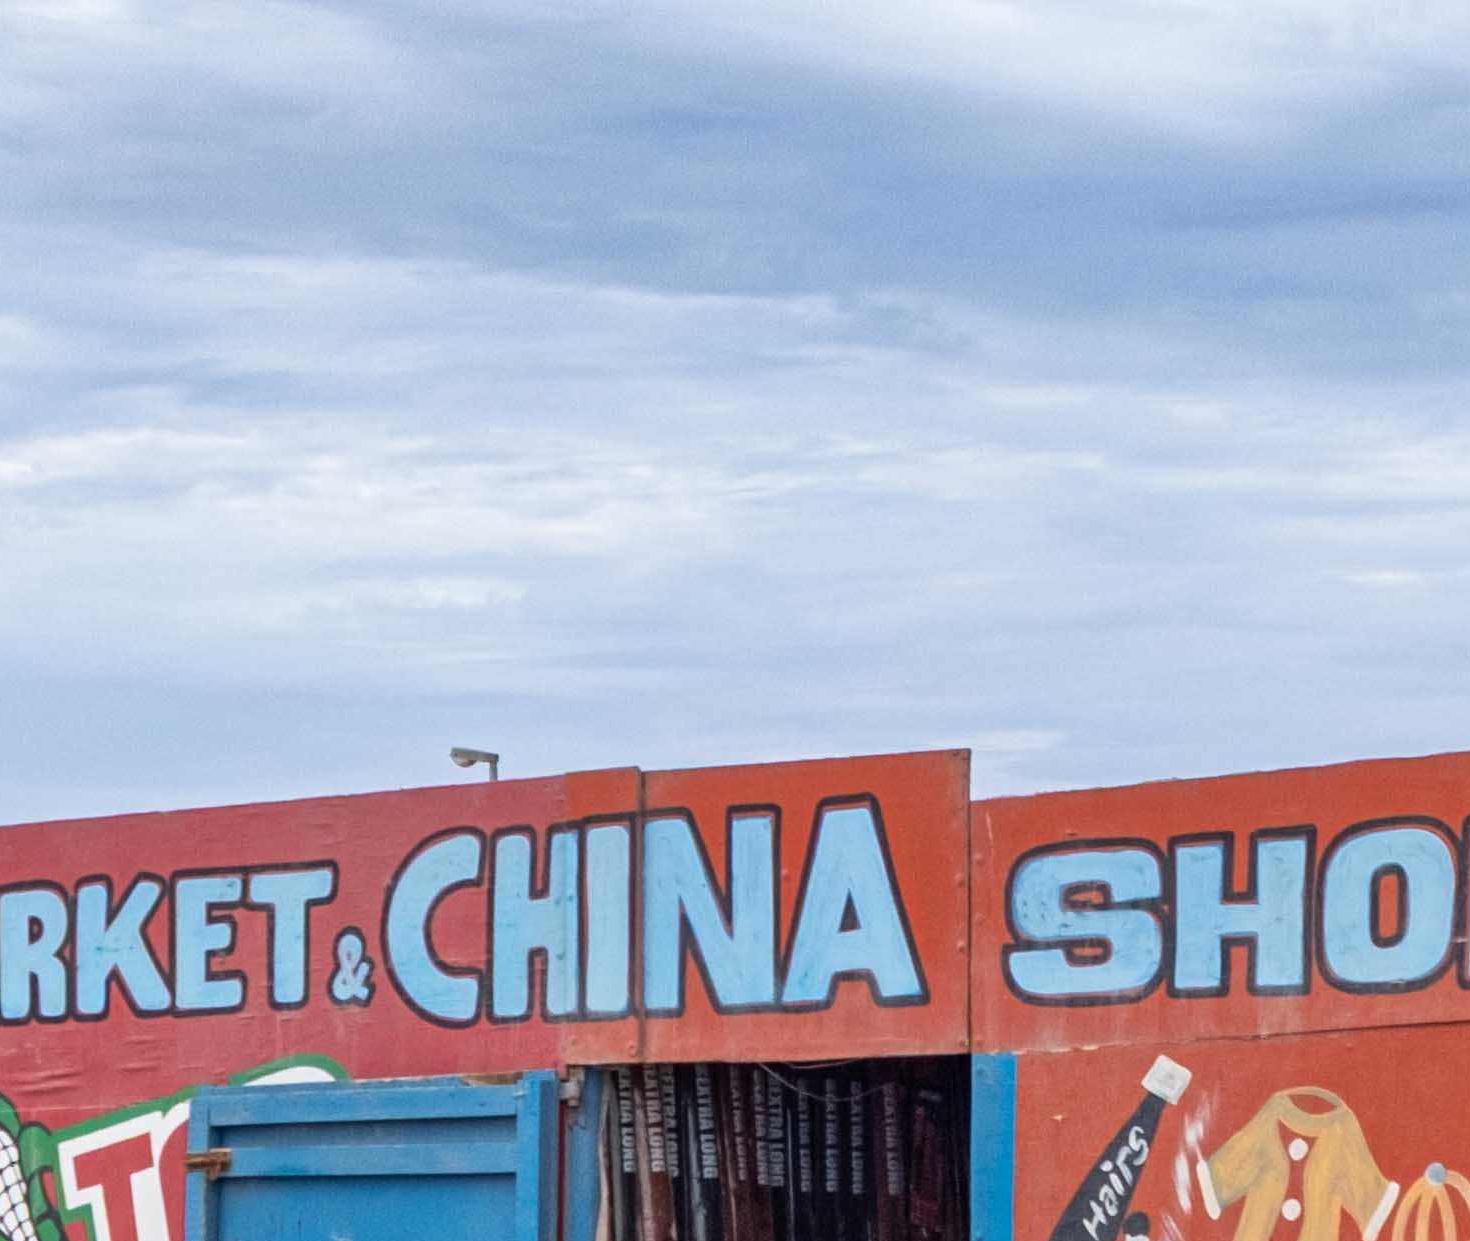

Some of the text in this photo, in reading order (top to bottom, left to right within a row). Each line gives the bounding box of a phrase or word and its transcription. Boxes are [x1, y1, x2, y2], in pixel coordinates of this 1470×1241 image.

[330, 926, 374, 1006] &
[383, 794, 931, 1029] CHINA
[700, 1133, 718, 1179] LONG
[769, 1142, 785, 1187] LONG
[1082, 1125, 1150, 1241] Hairs
